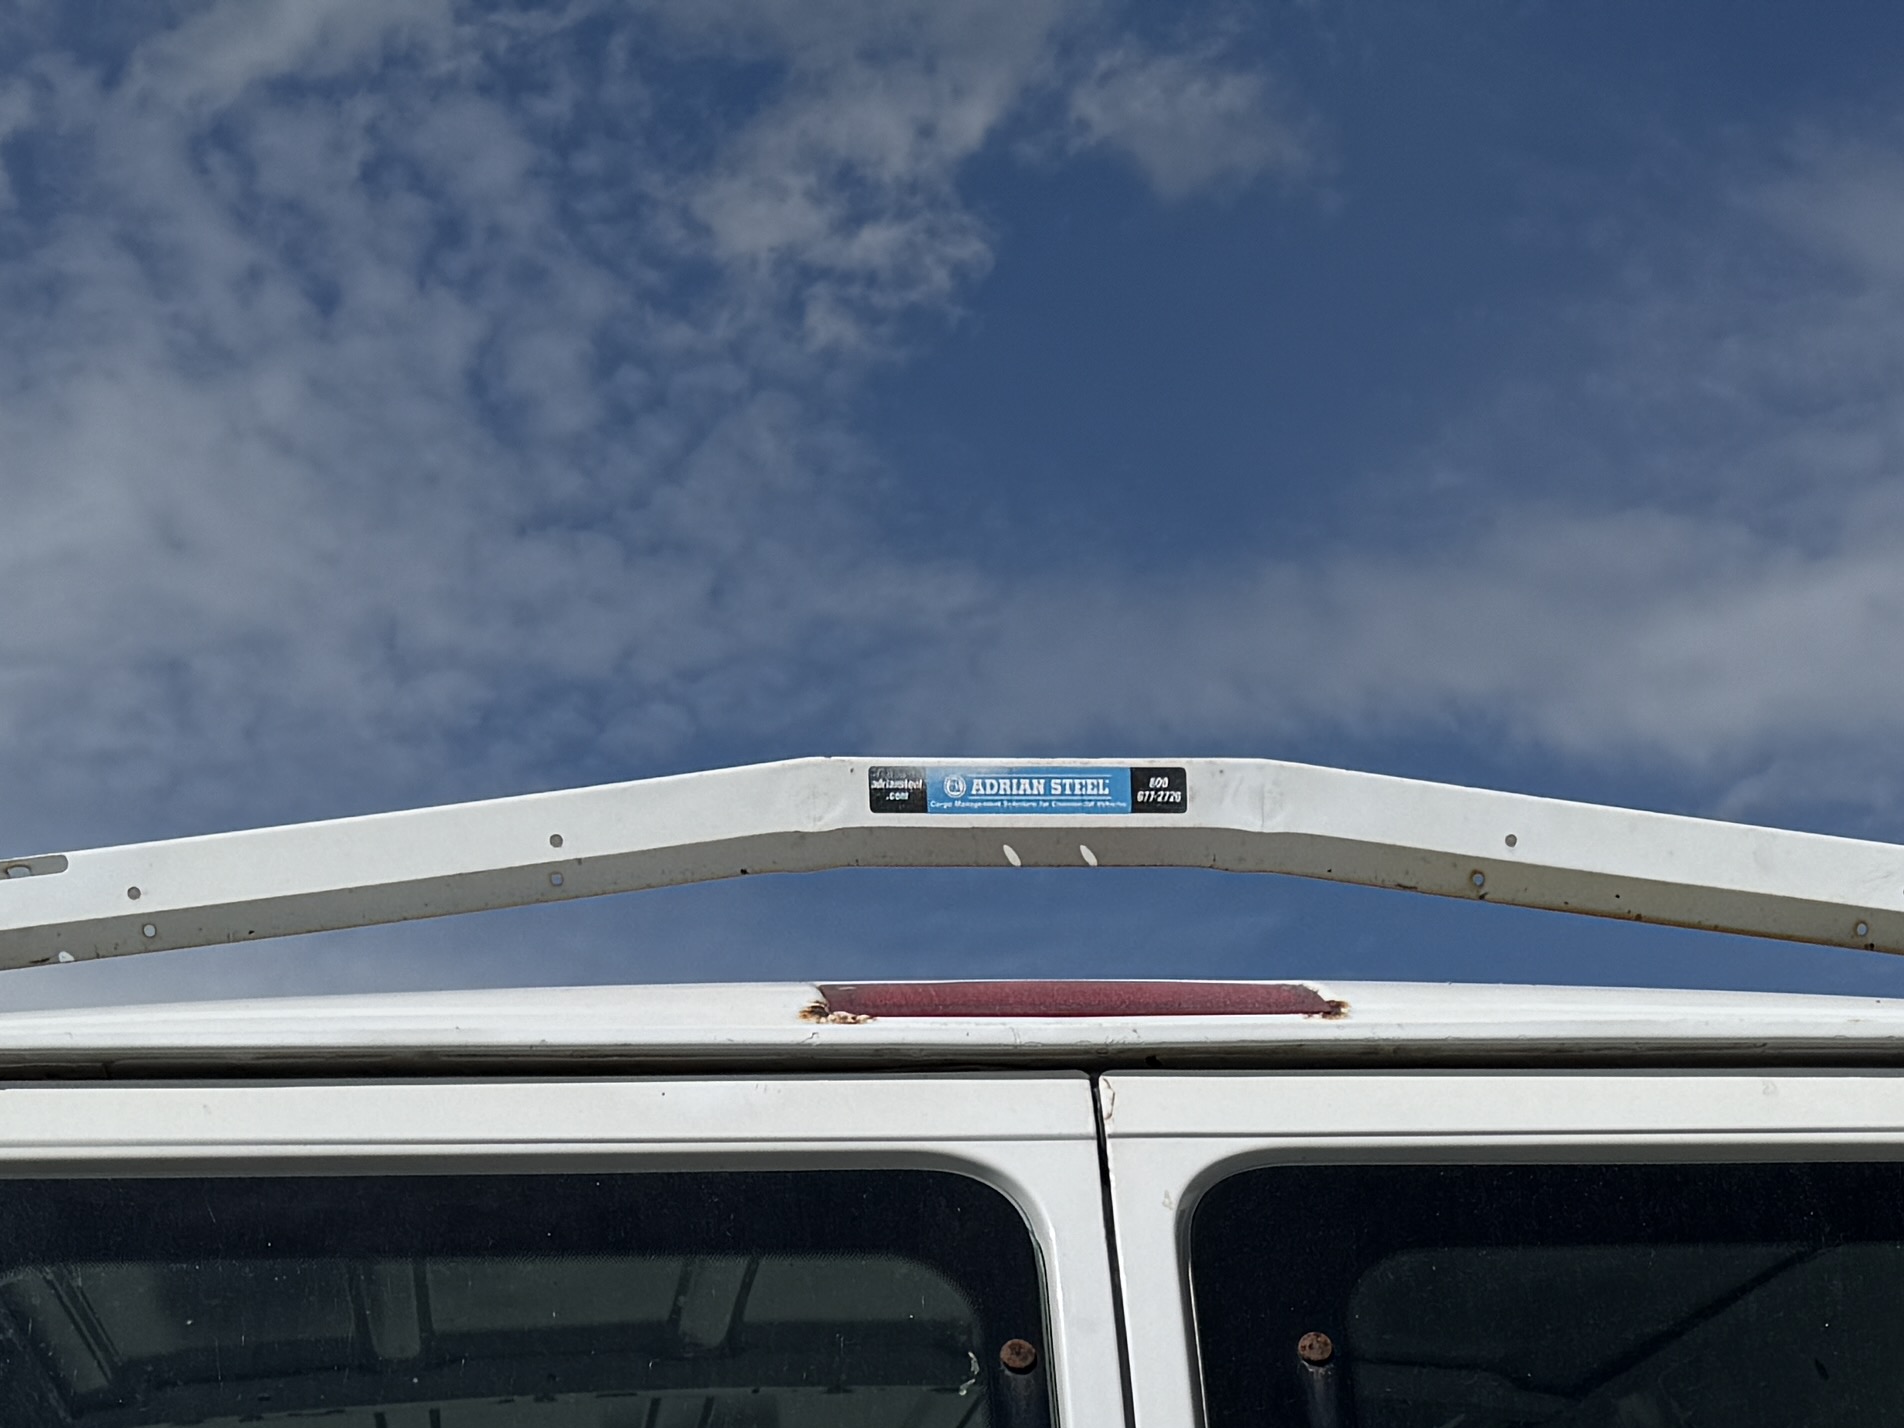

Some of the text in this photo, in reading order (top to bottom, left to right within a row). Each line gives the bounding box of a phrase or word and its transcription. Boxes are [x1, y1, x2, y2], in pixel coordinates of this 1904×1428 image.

[971, 778, 1109, 795] ADRIAN STEEL
[1149, 777, 1169, 788] 800
